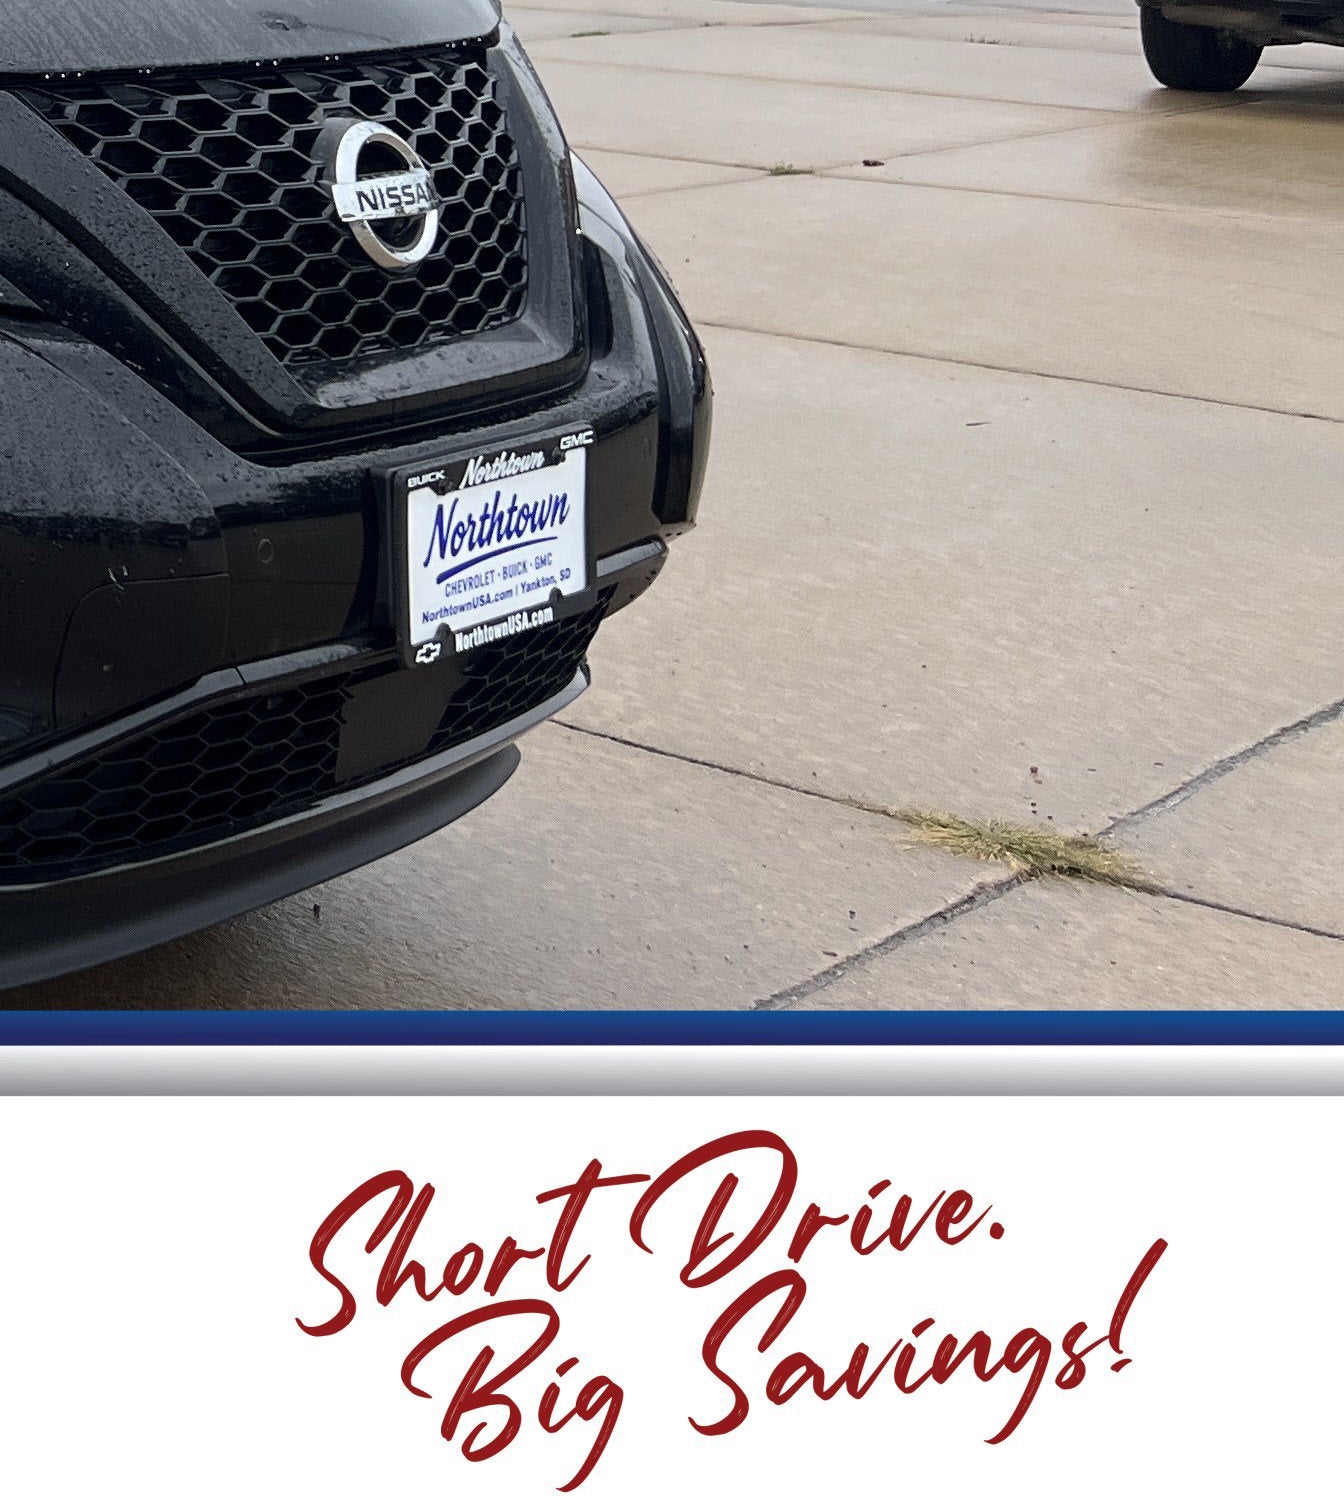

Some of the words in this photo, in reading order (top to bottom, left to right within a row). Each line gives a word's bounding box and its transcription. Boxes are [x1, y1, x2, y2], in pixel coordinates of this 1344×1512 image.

[407, 469, 445, 488] BUICK
[458, 450, 545, 490] Northtown
[559, 430, 594, 450] GMC
[423, 490, 570, 568] Northtown
[444, 569, 495, 597] CHEVROLET
[502, 558, 528, 581] BUICK
[534, 552, 553, 572] GMC
[422, 587, 513, 624] NorthtownUSA.com
[455, 606, 554, 652] NorthtownUSA.com
